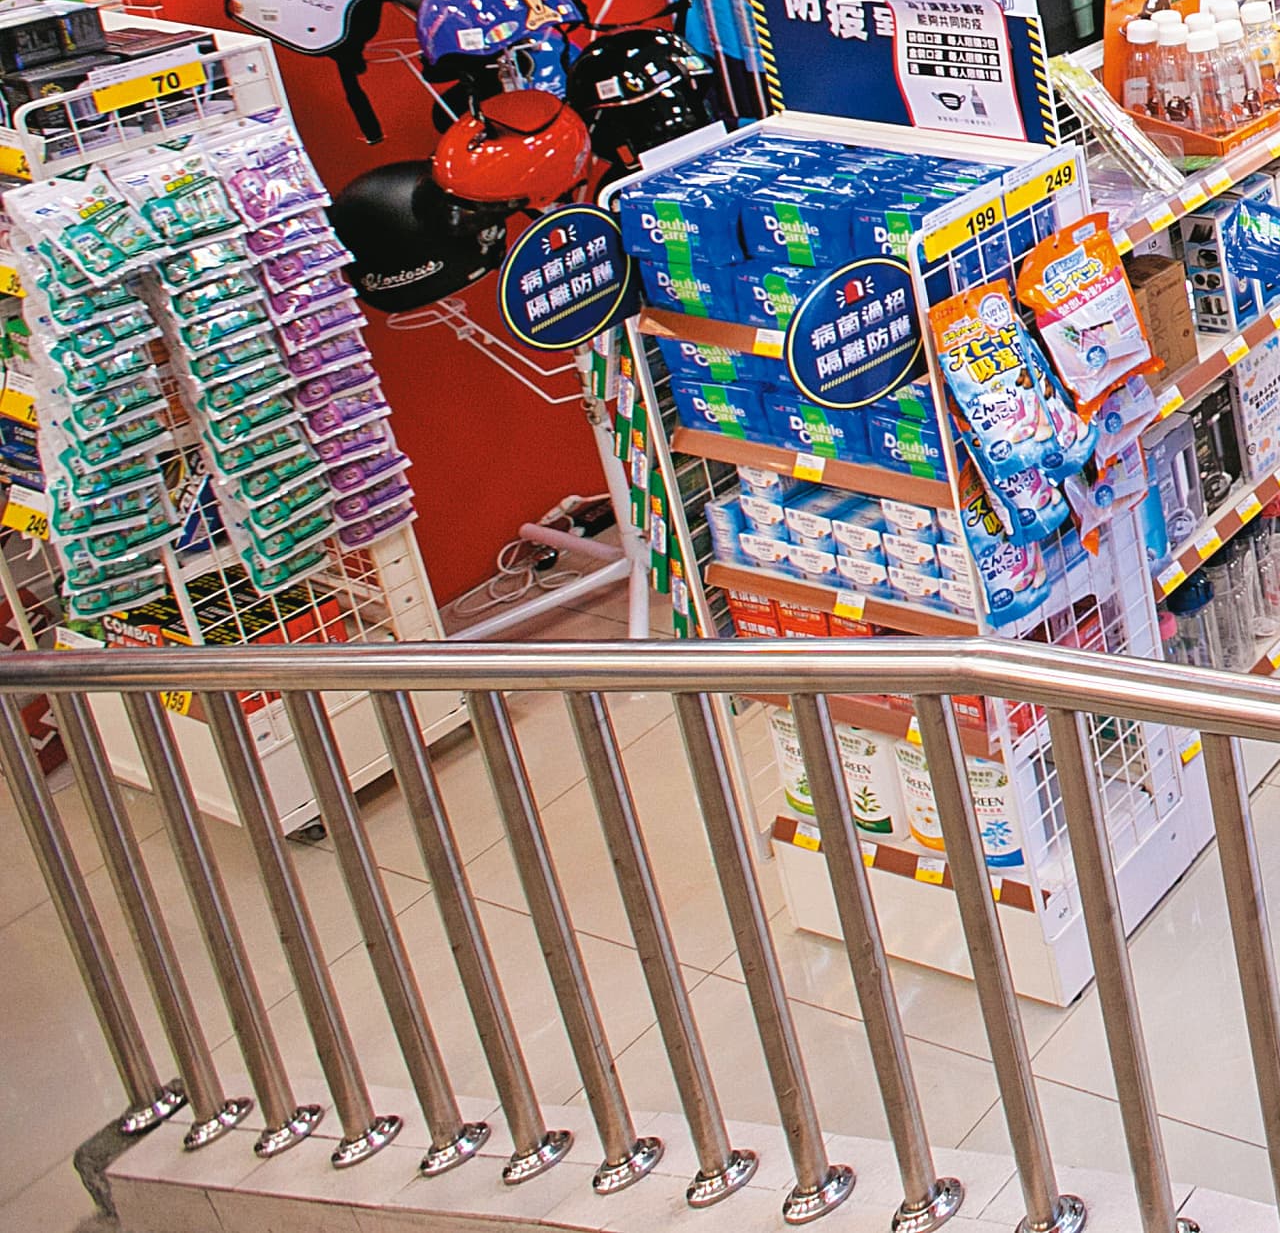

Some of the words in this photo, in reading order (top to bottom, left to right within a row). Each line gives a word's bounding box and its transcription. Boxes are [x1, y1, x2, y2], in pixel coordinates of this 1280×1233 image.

[151, 71, 181, 94] 70
[1044, 165, 1073, 194] 249
[641, 213, 699, 235] Double
[763, 214, 820, 236] Double
[965, 206, 996, 236] 199
[650, 228, 689, 244] Care
[771, 229, 810, 245] Care
[874, 226, 911, 245] Doub
[520, 234, 608, 296] 病菌過招
[525, 260, 615, 321] 隔離防護
[657, 271, 711, 293] Double
[665, 285, 700, 301] Care
[810, 288, 908, 351] 病菌過招
[814, 314, 913, 379] 隔離防護
[694, 353, 732, 367] Care
[692, 396, 746, 418] Double
[704, 410, 738, 424] Care
[789, 415, 845, 439] Double
[799, 429, 835, 444] Care
[884, 432, 940, 459] Double
[891, 446, 927, 464] Care
[26, 514, 48, 536] 249
[103, 616, 159, 645] COMBAT
[163, 691, 185, 712] 159
[844, 761, 872, 775] REEN
[972, 796, 1005, 807] REEN
